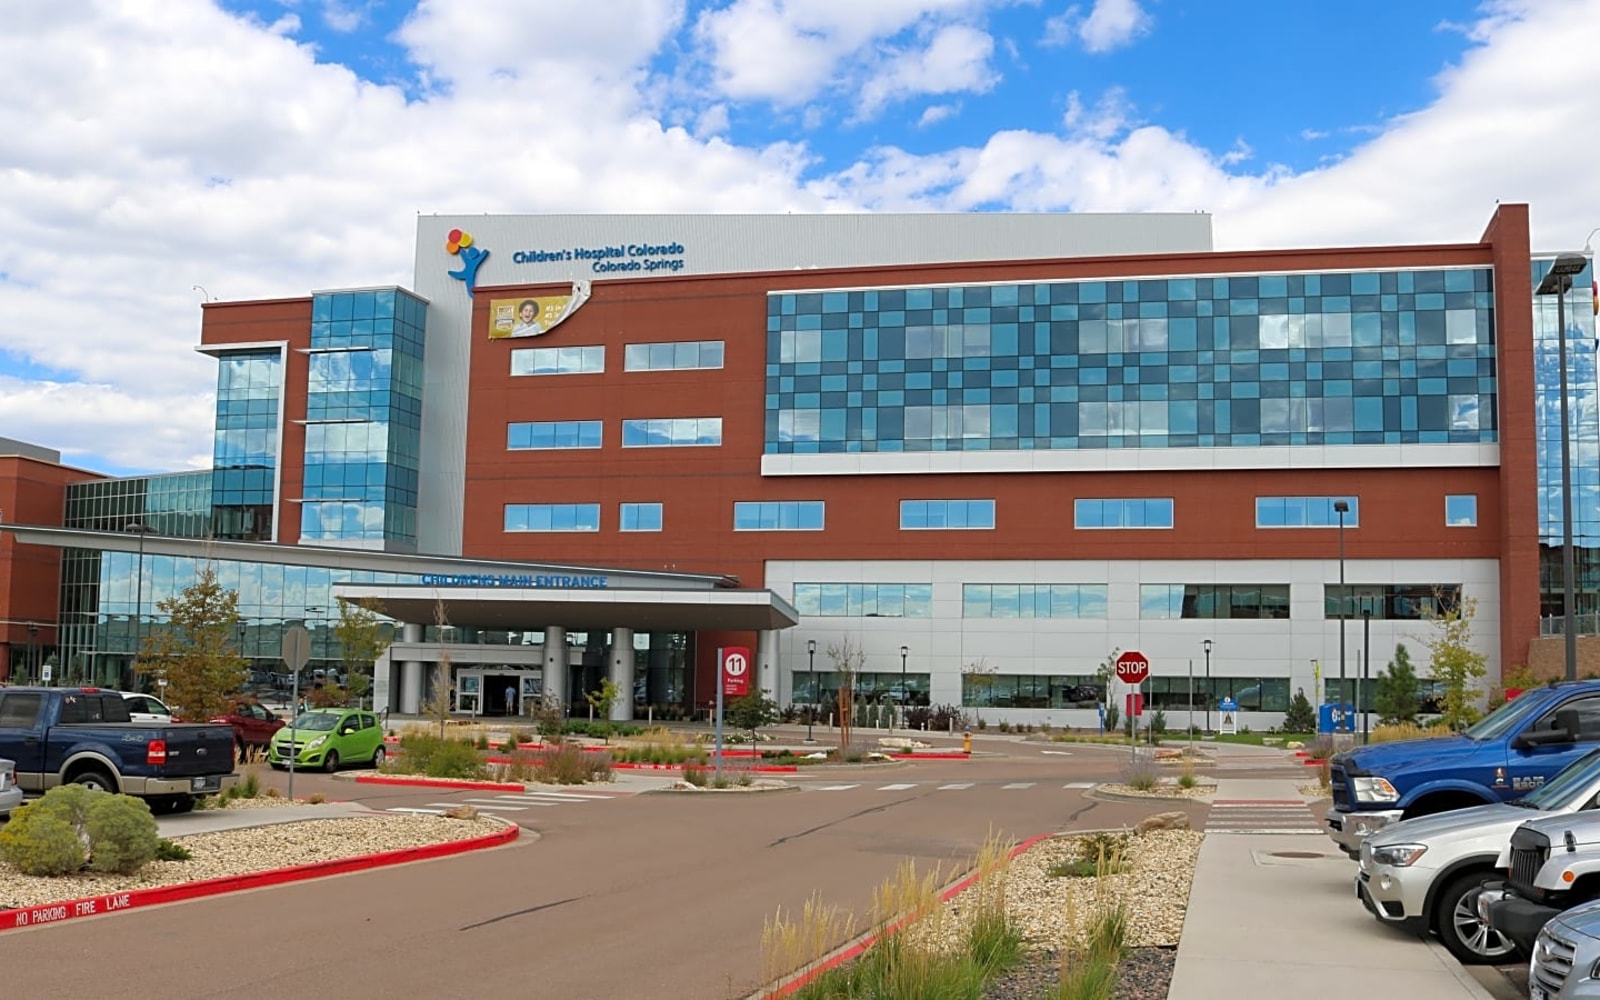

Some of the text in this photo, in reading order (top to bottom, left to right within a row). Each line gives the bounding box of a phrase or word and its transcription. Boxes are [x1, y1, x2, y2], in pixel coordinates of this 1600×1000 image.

[513, 241, 685, 264] Children's Hospital Colorado
[592, 257, 684, 273] Colorado Springs
[422, 573, 608, 588] CHILDRENS MAIN ENTRANCE
[729, 657, 742, 672] 11
[1118, 661, 1147, 674] STOP
[16, 894, 130, 927] NO PARKING FIRE LANE
